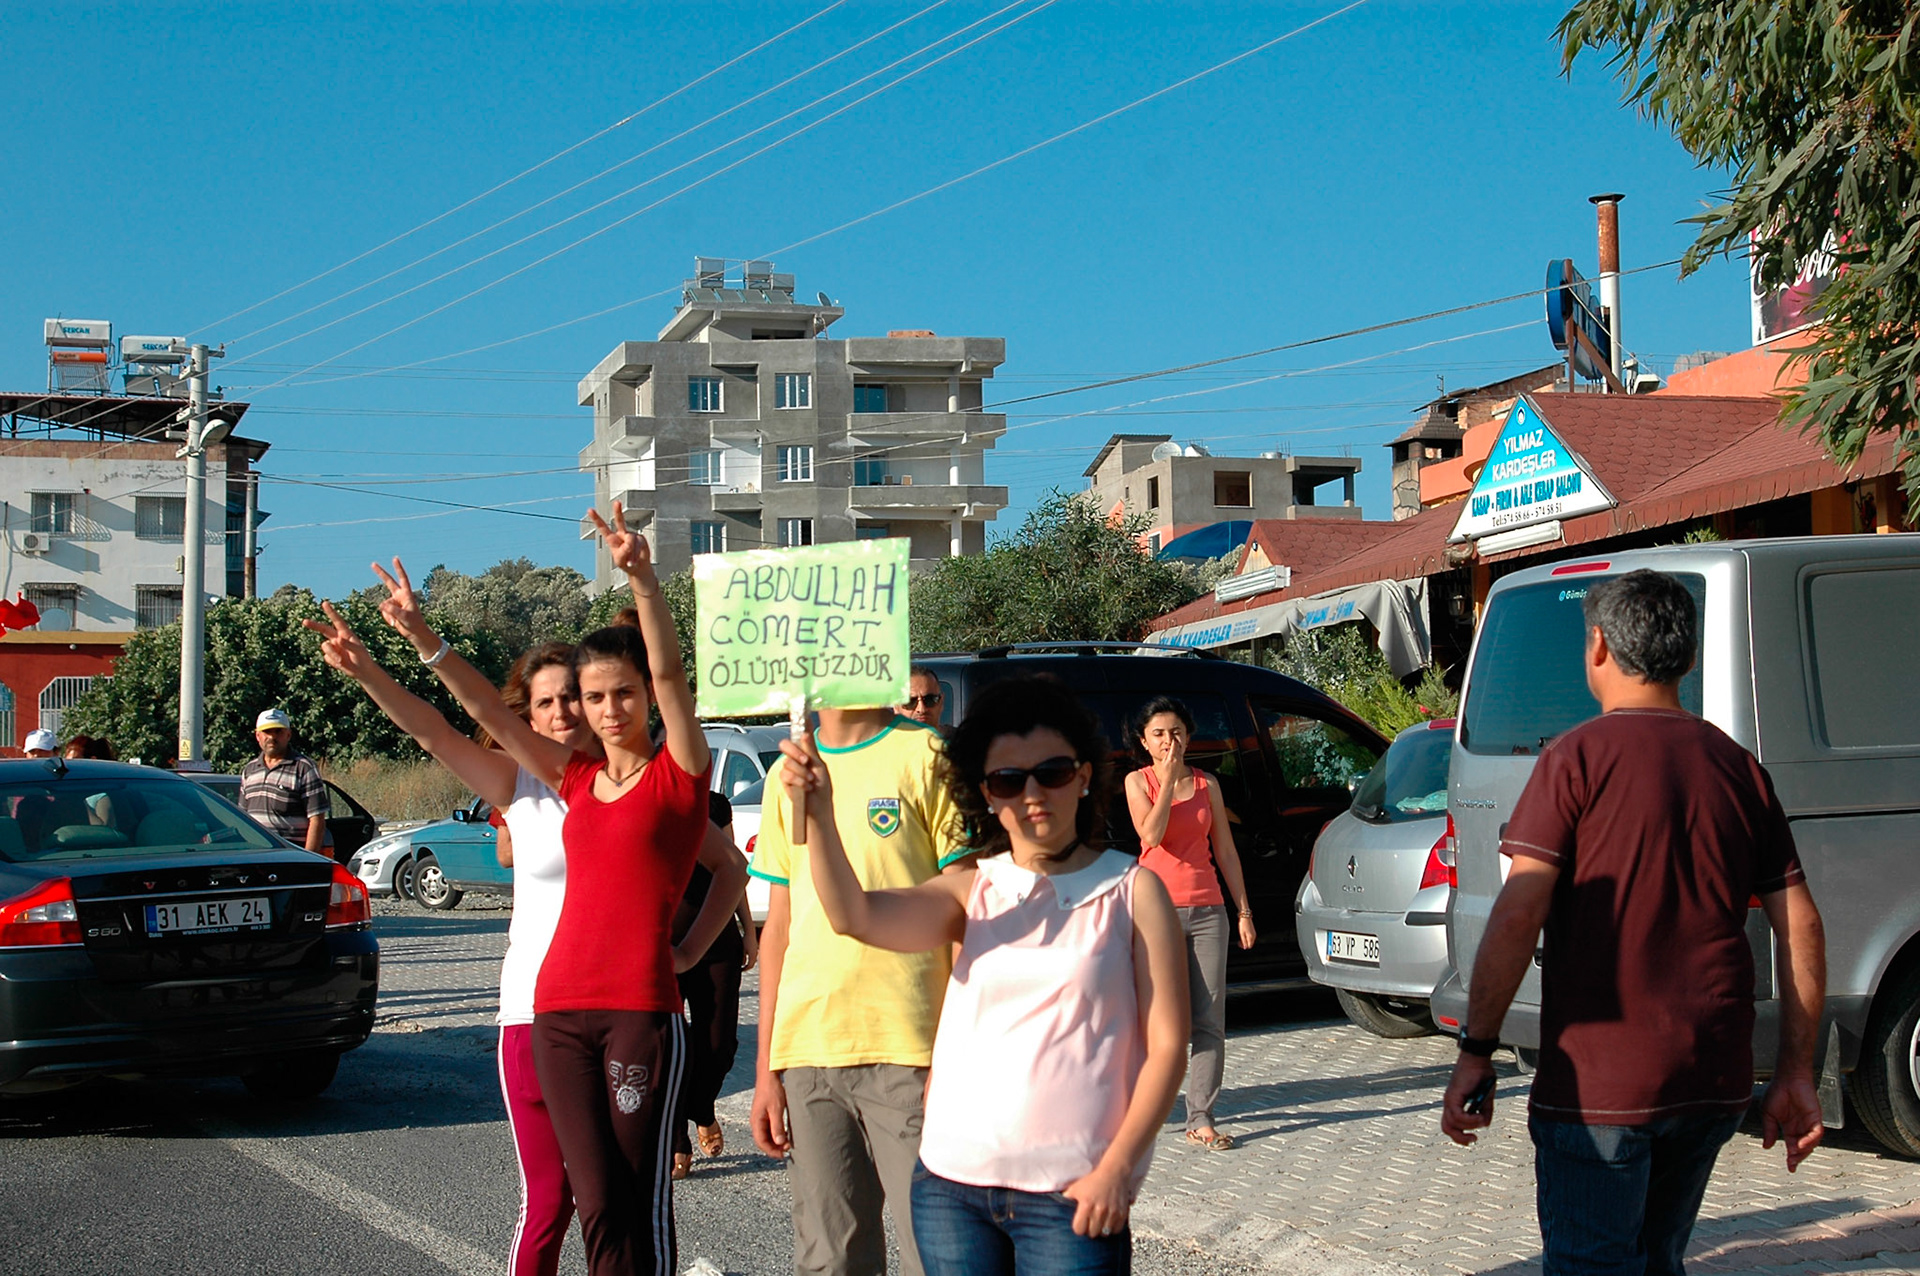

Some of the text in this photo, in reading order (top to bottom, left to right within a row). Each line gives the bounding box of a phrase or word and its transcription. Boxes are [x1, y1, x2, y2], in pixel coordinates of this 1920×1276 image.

[1503, 429, 1544, 455] YILMAZ
[1492, 449, 1557, 482] KARDEŞLER
[1471, 494, 1491, 517] KASAP
[1534, 478, 1554, 503] KEBAP
[1556, 471, 1582, 498] SALONU
[723, 562, 896, 615] ABDULLAH
[710, 611, 882, 648] CÖMERT
[710, 646, 893, 688] ÖLÜMSÜZDÜR
[869, 799, 896, 807] BRASIL
[142, 873, 279, 890] VOLVO
[158, 901, 264, 929] 31 AEK 24
[1363, 938, 1380, 959] 586
